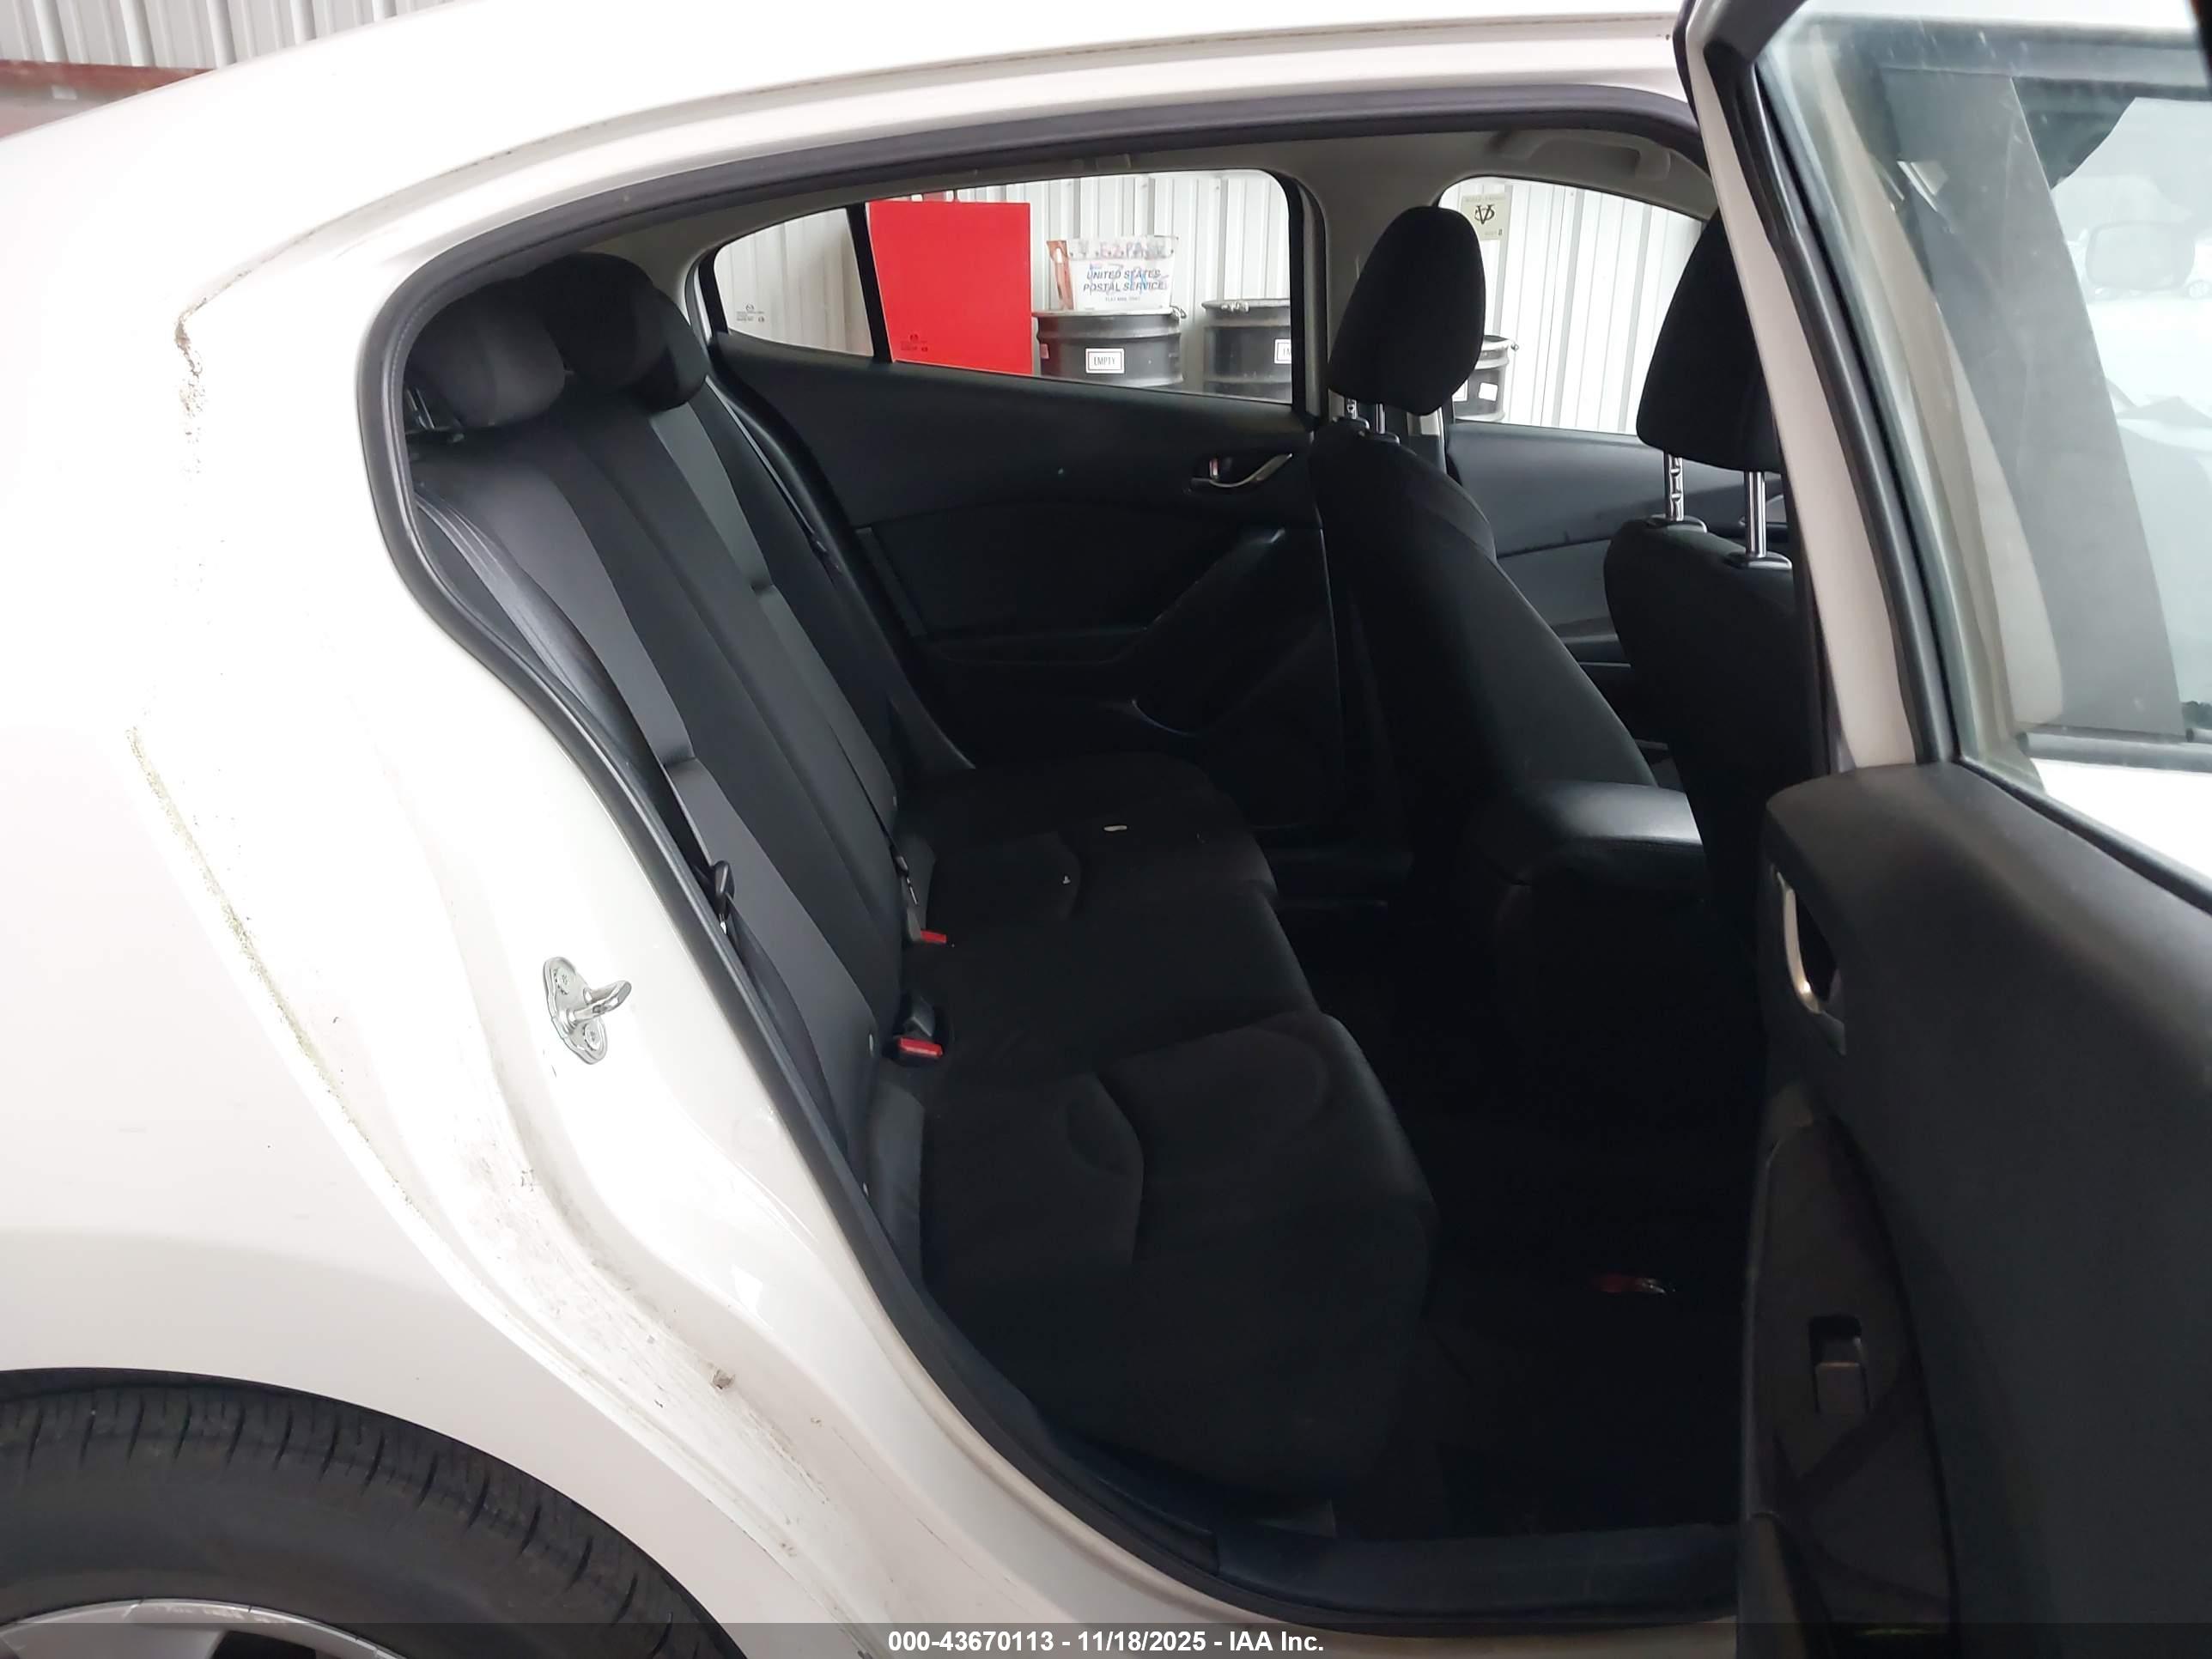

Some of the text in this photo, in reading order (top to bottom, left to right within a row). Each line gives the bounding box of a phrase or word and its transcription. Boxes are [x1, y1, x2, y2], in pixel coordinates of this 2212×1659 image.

[1086, 269, 1162, 280] UNITED STATES
[1083, 281, 1164, 293] POSTAL SERVICE
[1093, 356, 1116, 366] EMPTY
